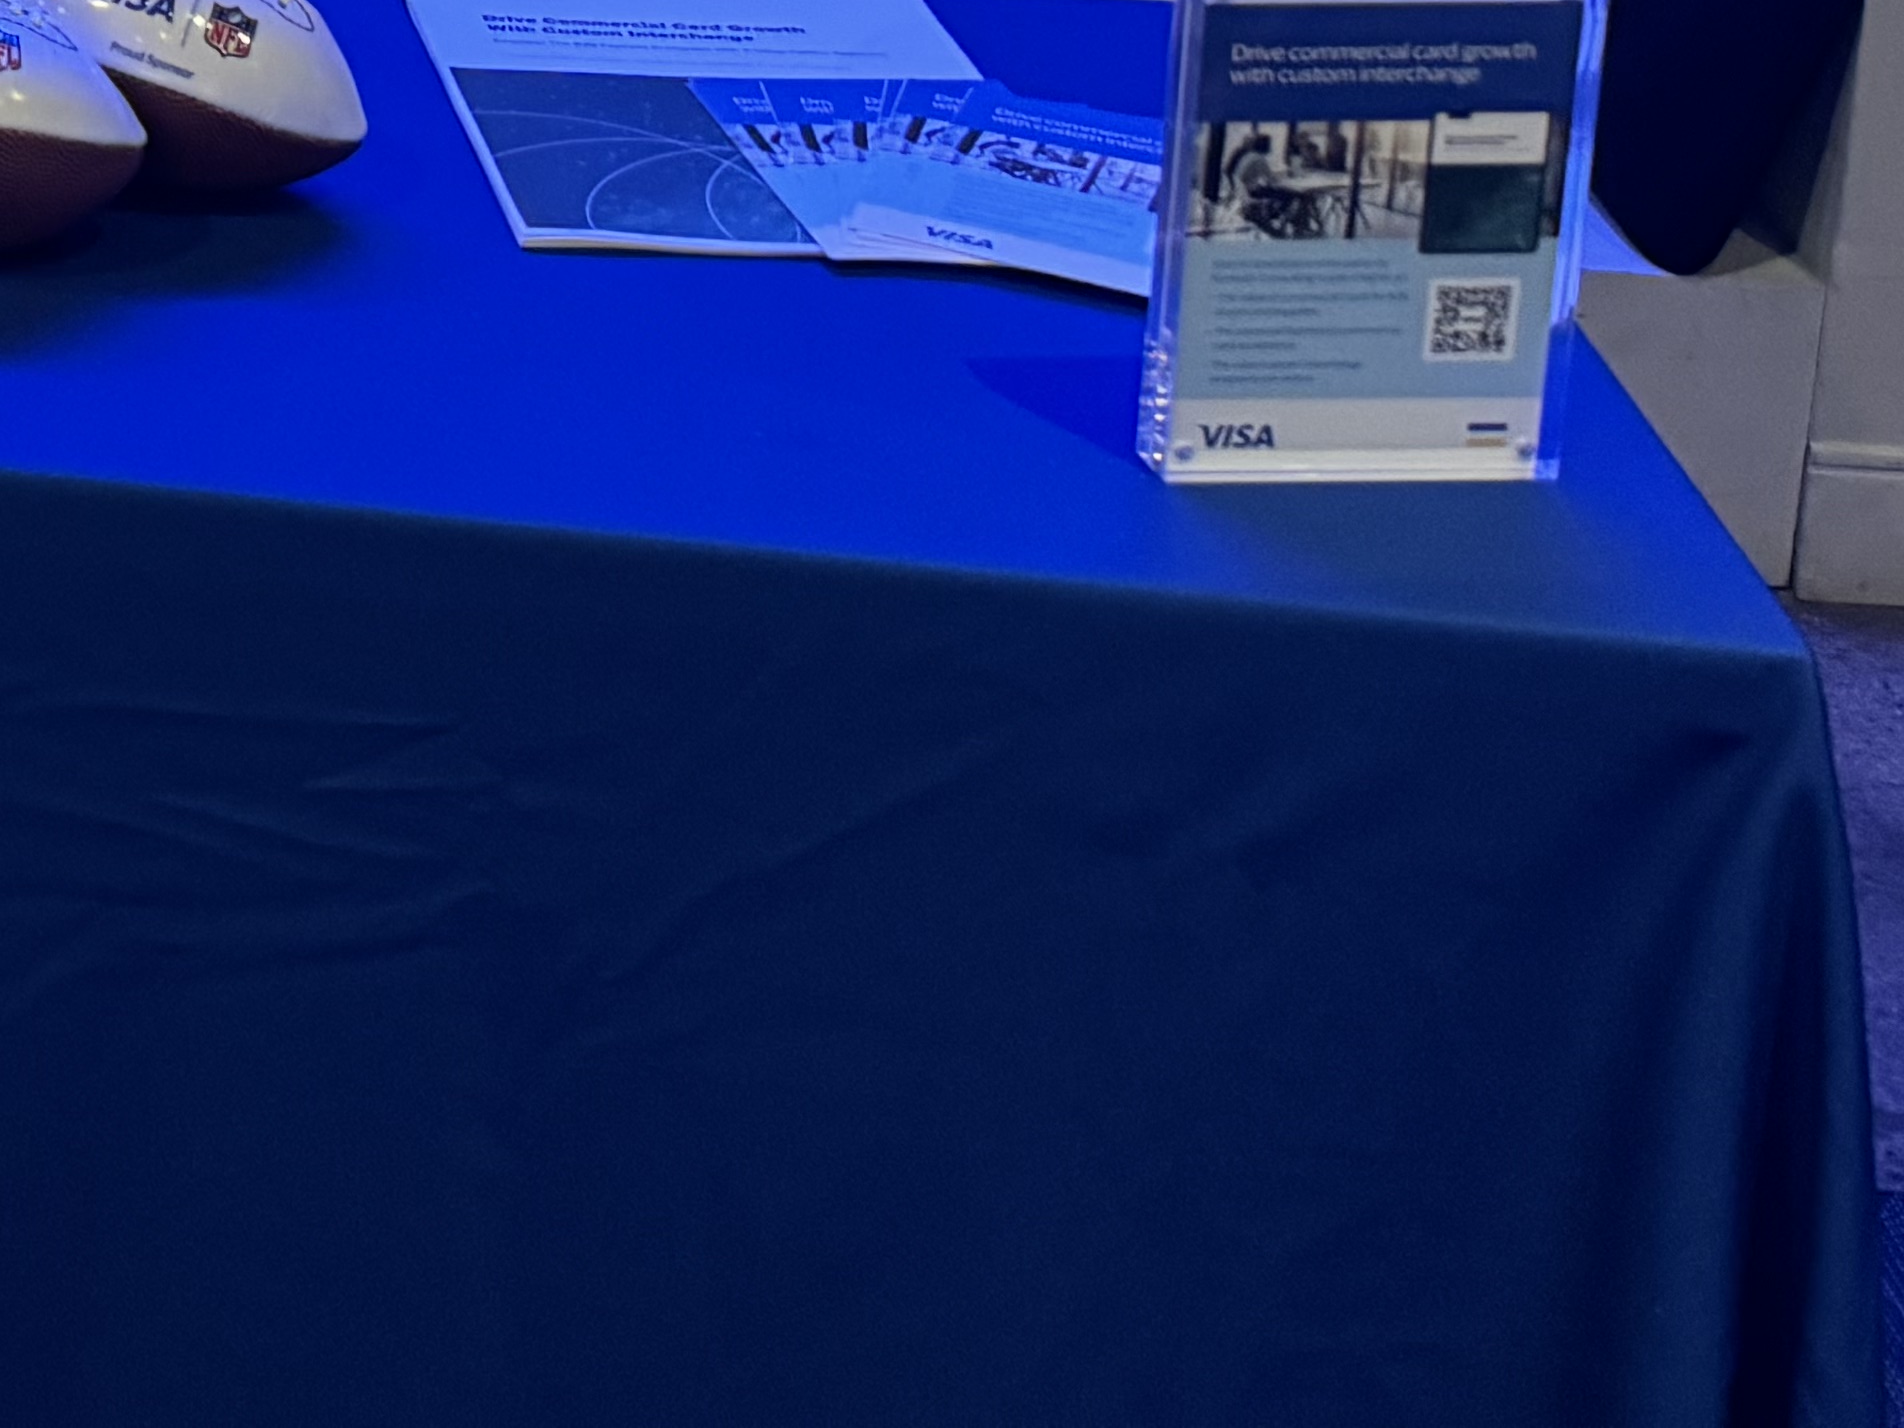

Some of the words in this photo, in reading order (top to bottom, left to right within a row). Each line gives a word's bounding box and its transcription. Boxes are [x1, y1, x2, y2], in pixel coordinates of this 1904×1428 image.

[1230, 42, 1286, 62] Drive
[1287, 42, 1411, 61] commercial
[1411, 41, 1459, 60] card
[1460, 41, 1538, 63] growth
[1229, 67, 1276, 84] with
[1276, 67, 1358, 84] custom
[1358, 65, 1482, 86] interchange
[925, 225, 994, 249] VISA
[1196, 423, 1276, 450] VISA
